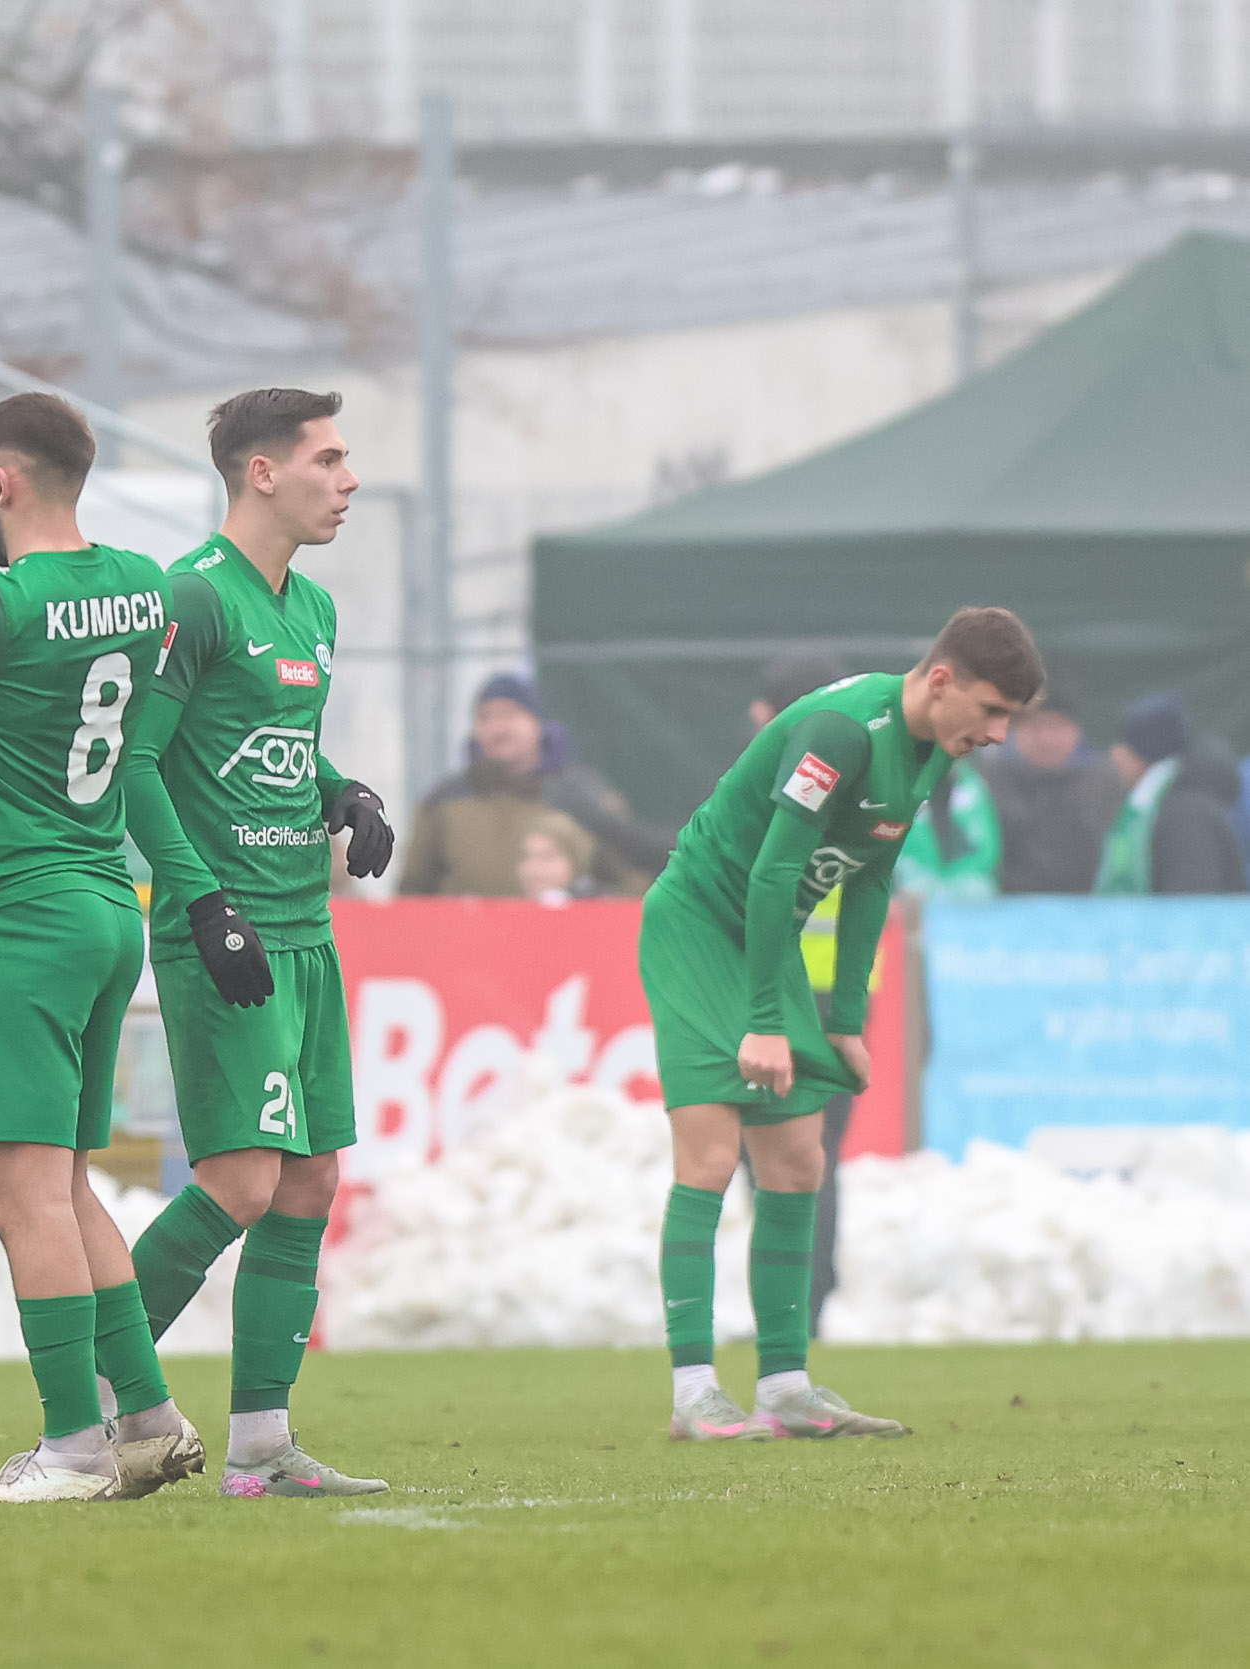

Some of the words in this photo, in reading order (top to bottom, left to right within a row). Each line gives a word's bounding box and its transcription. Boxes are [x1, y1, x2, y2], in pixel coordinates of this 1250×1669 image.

[46, 590, 165, 641] KUMOCH
[280, 662, 315, 683] Betclic
[65, 651, 134, 806] 8
